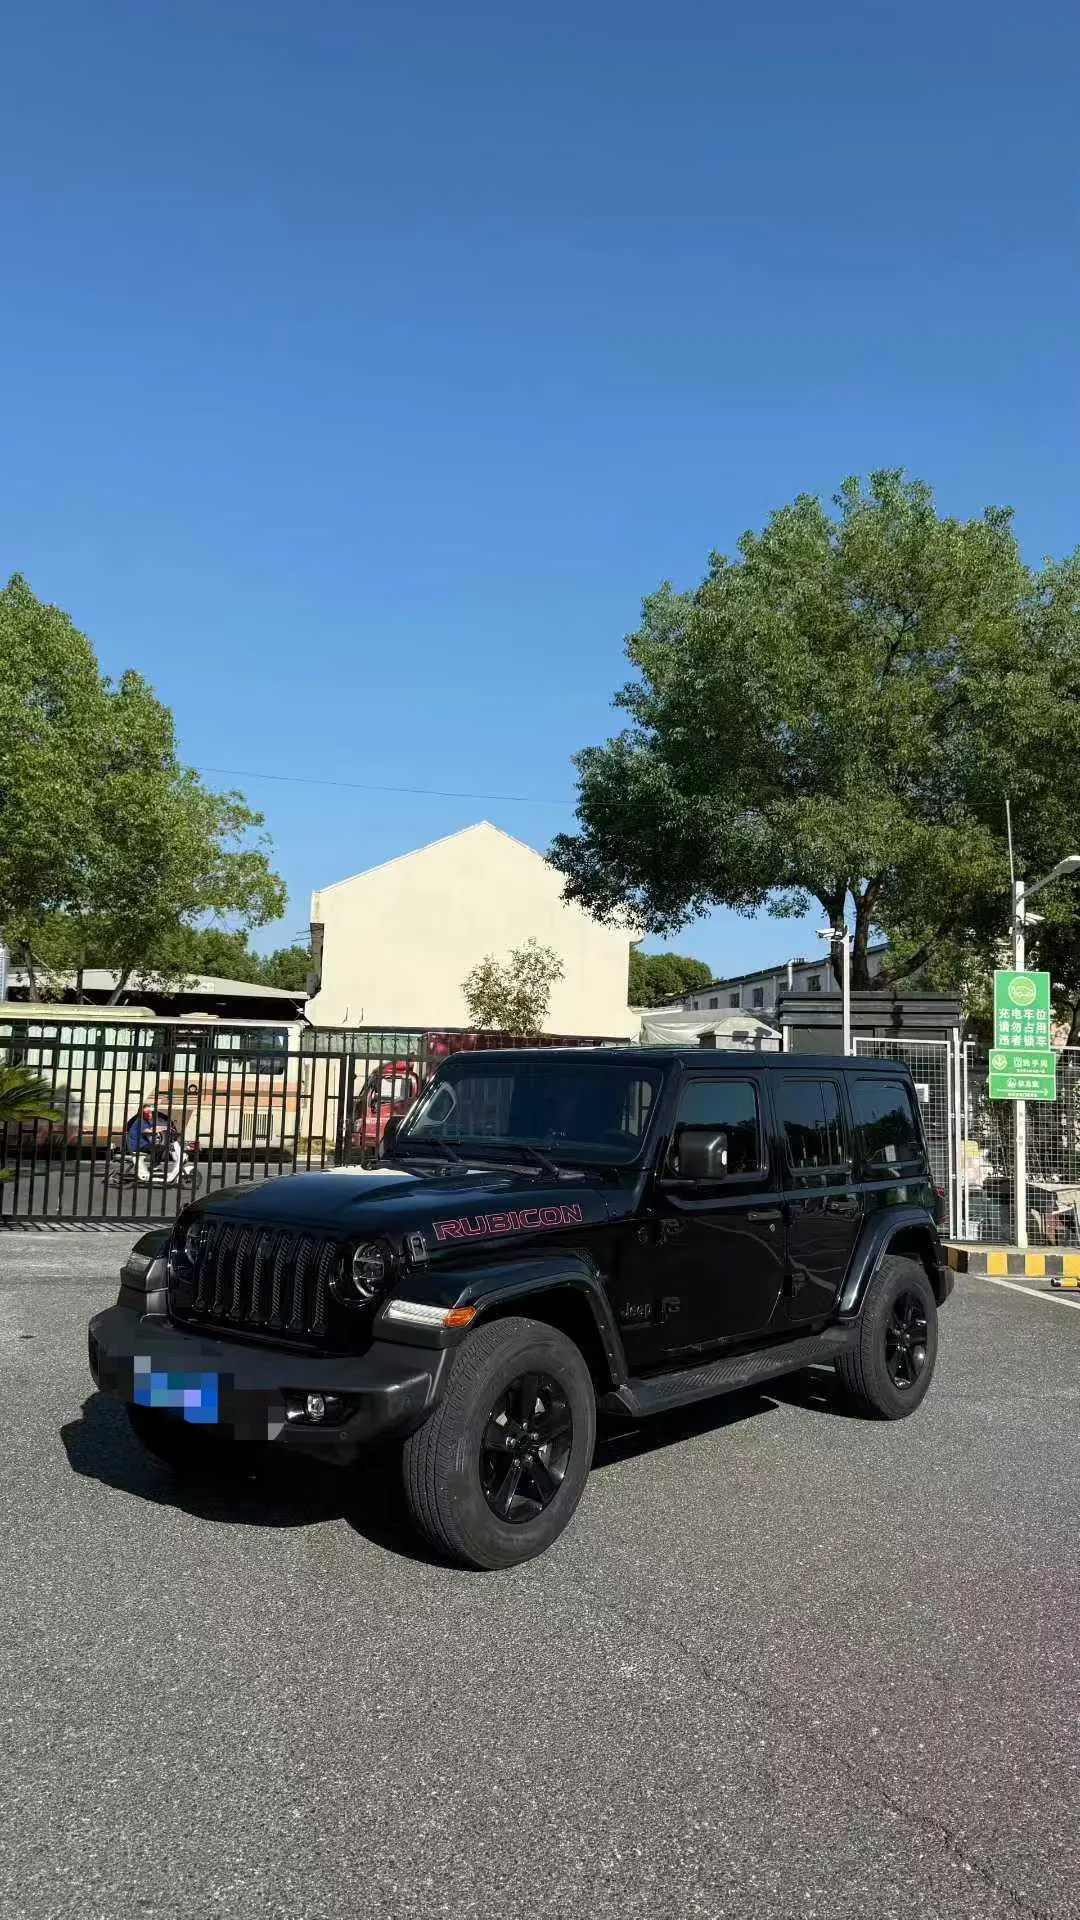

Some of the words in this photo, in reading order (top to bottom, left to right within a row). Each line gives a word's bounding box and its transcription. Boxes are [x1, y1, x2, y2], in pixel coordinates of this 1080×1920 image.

[998, 1008, 1047, 1020] 充电车位
[998, 1021, 1047, 1033] 请勿占用
[998, 1034, 1048, 1046] 违者锁车
[432, 1203, 584, 1241] RUBICON
